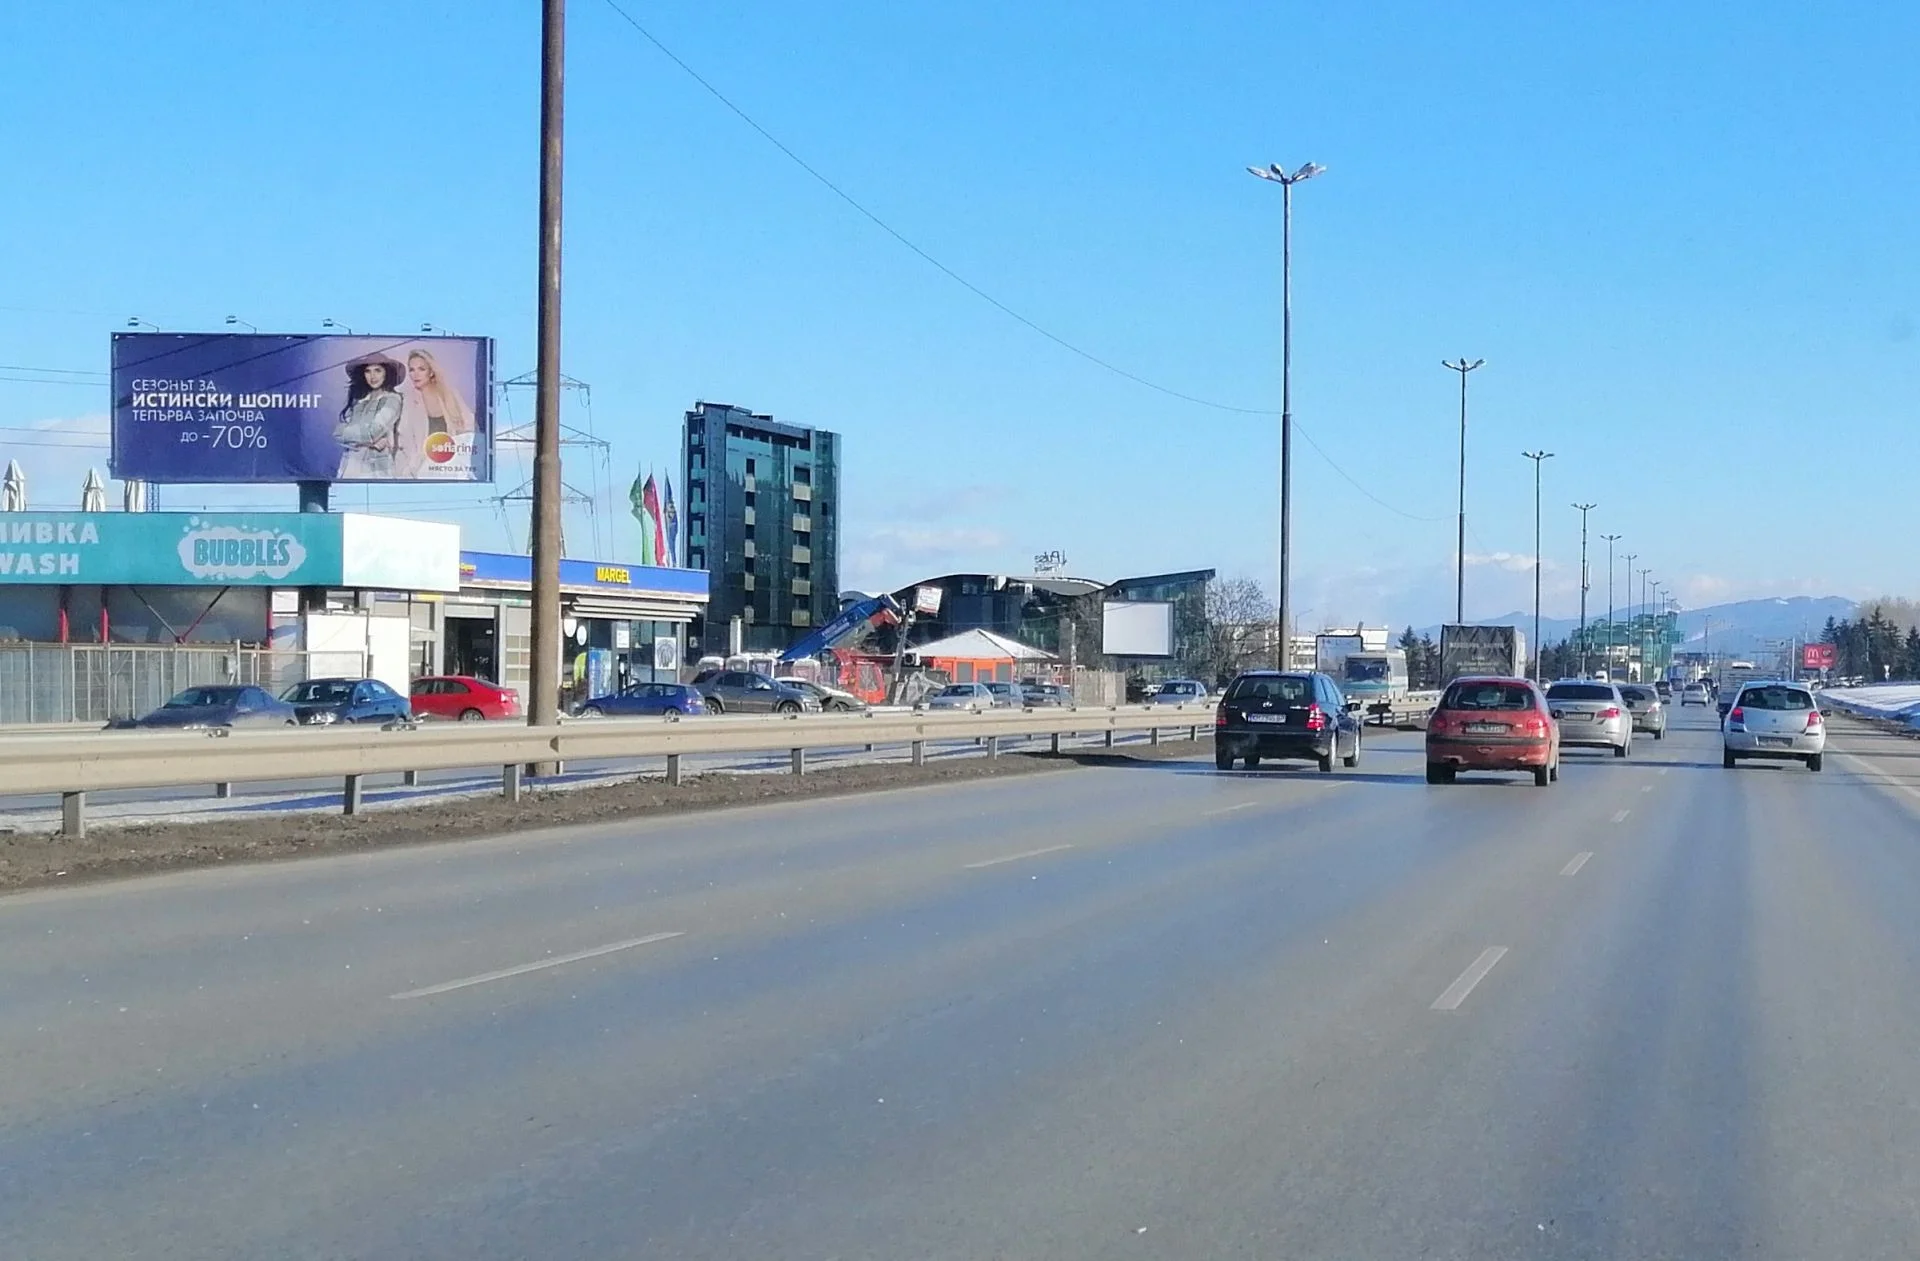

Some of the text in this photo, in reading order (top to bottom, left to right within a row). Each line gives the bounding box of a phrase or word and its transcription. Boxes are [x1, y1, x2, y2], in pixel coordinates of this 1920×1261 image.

[198, 379, 217, 392] ЗА
[131, 393, 322, 409] ИСТИНСКИ ШОПИНГ
[131, 409, 266, 422] ТЕПЪРВА ЗАПОЧВА
[202, 425, 268, 449] -70%
[0, 521, 100, 545] ИВКА
[194, 538, 291, 566] BUBBLES
[595, 567, 632, 584] MARGEL
